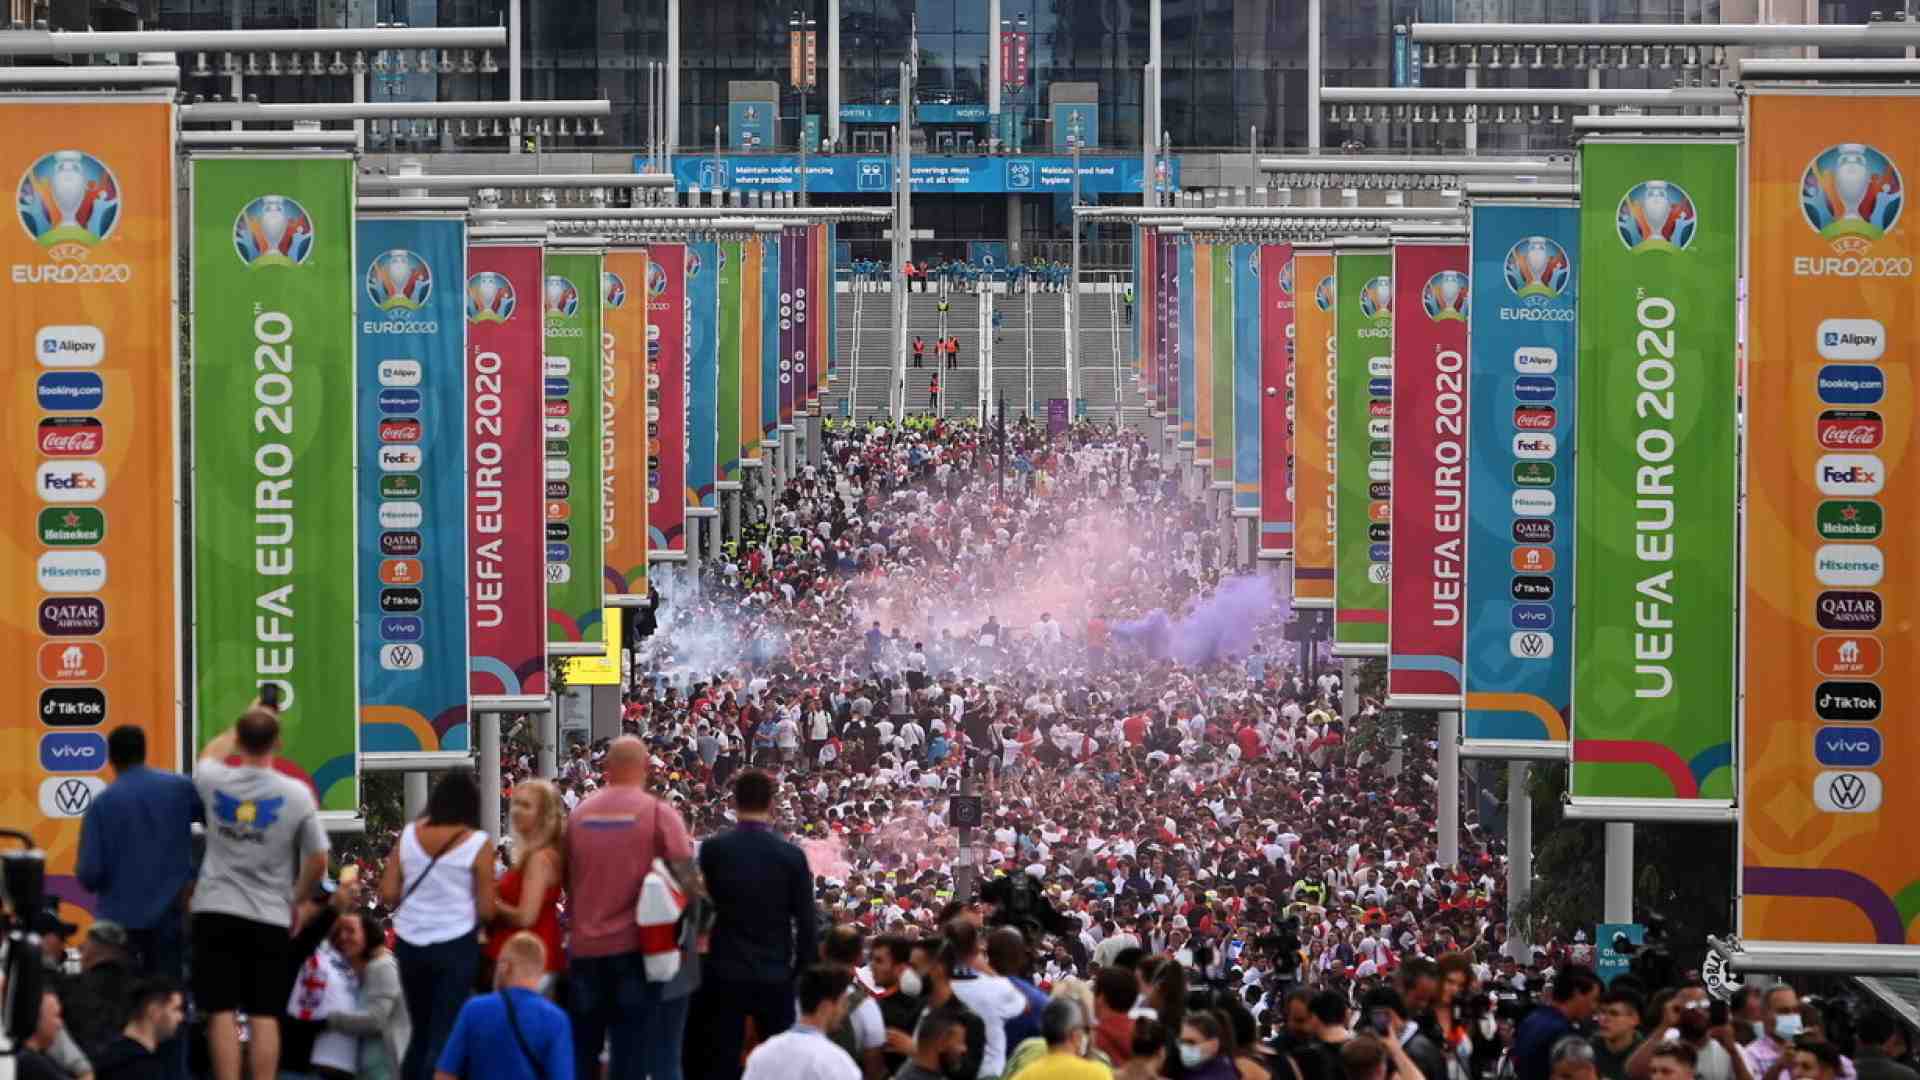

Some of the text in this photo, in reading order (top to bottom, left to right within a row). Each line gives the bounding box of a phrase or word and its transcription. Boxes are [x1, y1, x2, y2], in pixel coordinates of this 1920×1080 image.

[771, 166, 792, 174] social
[950, 167, 970, 175] must
[1095, 166, 1114, 175] hand
[736, 176, 793, 184] where possible
[947, 176, 969, 184] times
[1041, 176, 1070, 185] hygiene
[1794, 256, 1912, 276] EURO2020
[12, 264, 129, 283] EURO2020
[1500, 307, 1574, 320] EURO2020
[363, 321, 438, 334] EURO2020
[1840, 333, 1877, 346] Alipay
[58, 340, 96, 353] Alipay
[1529, 356, 1552, 365] Alipay
[1637, 297, 1676, 420] 2020
[254, 311, 294, 434] 2020
[393, 368, 417, 378] Alipay
[39, 385, 101, 397] Booking.com
[1820, 379, 1882, 391] Booking.com
[475, 352, 502, 436] 2020
[1435, 350, 1463, 436] 2020
[1518, 440, 1551, 452] FedEx
[383, 452, 416, 464] FedEx
[1824, 466, 1876, 483] FedEx
[44, 473, 96, 489] FedEx
[476, 442, 502, 533] EURO
[1434, 442, 1462, 533] EURO
[1636, 429, 1675, 561] EURO
[255, 443, 294, 576] EURO
[1516, 523, 1551, 535] QATAR
[1823, 522, 1876, 533] Heineken
[44, 529, 97, 539] Heineken
[383, 535, 418, 546] QATAR
[1819, 559, 1880, 571] Hisense
[41, 566, 101, 577] Hisense
[477, 539, 502, 627] UEFA
[1433, 538, 1461, 627] UEFA
[1523, 584, 1551, 593] TikTok
[391, 597, 419, 605] TikTok
[1822, 599, 1875, 615] QATAR
[44, 605, 98, 621] QATAR
[1518, 612, 1546, 621] vivo
[1835, 613, 1877, 622] AIRWAYS
[57, 619, 99, 628] AIRWAYS
[388, 624, 415, 633] vivo
[1634, 570, 1674, 698] UEFA
[59, 702, 101, 714] TikTok
[1834, 696, 1877, 709] TikTok
[51, 745, 95, 757] vivo
[1827, 739, 1870, 752] vivo
[1599, 958, 1616, 967] Fan
